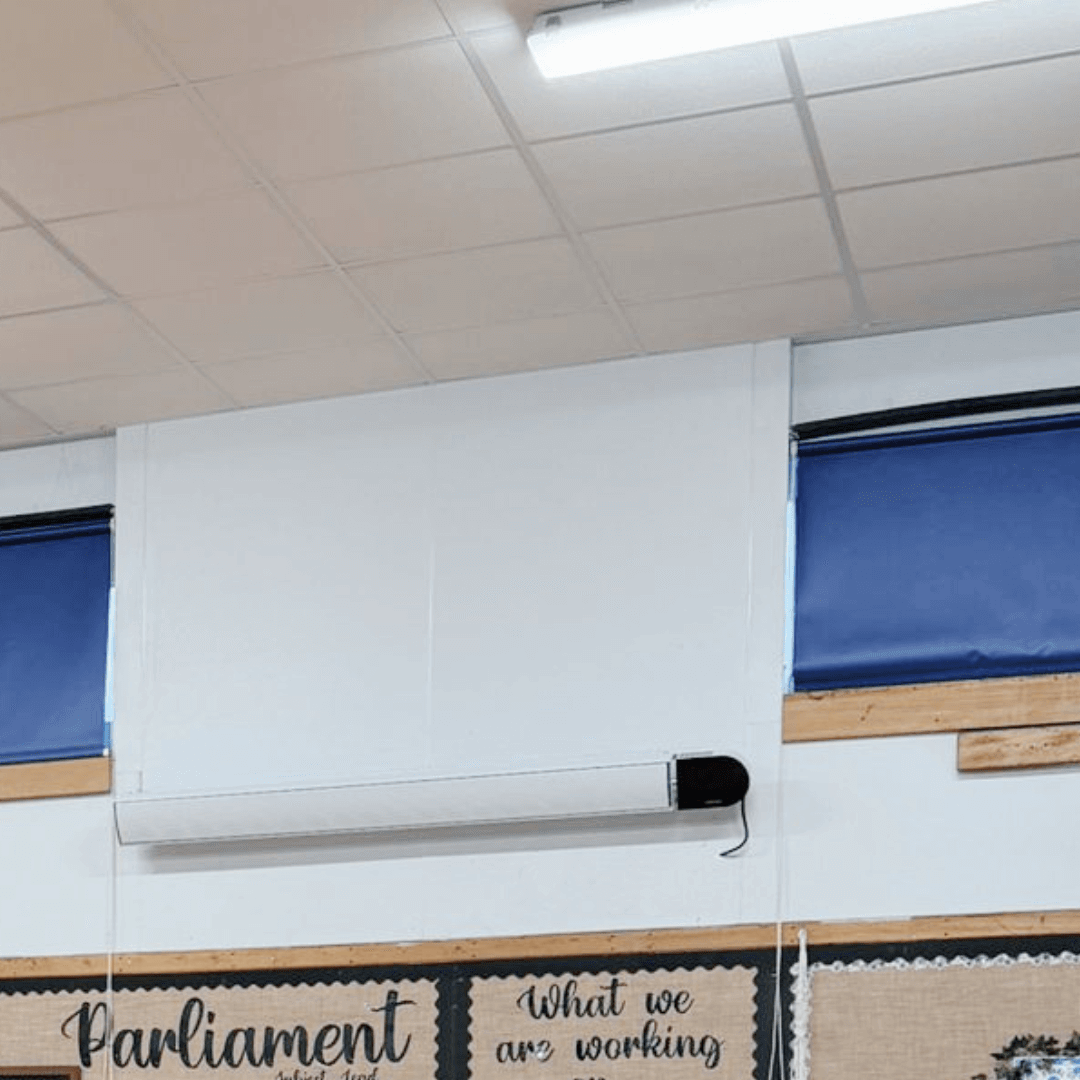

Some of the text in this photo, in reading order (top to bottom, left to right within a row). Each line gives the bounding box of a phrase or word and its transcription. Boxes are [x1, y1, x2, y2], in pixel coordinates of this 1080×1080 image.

[516, 978, 695, 1020] What we
[61, 990, 416, 1069] Parliament
[496, 1019, 725, 1069] are working
